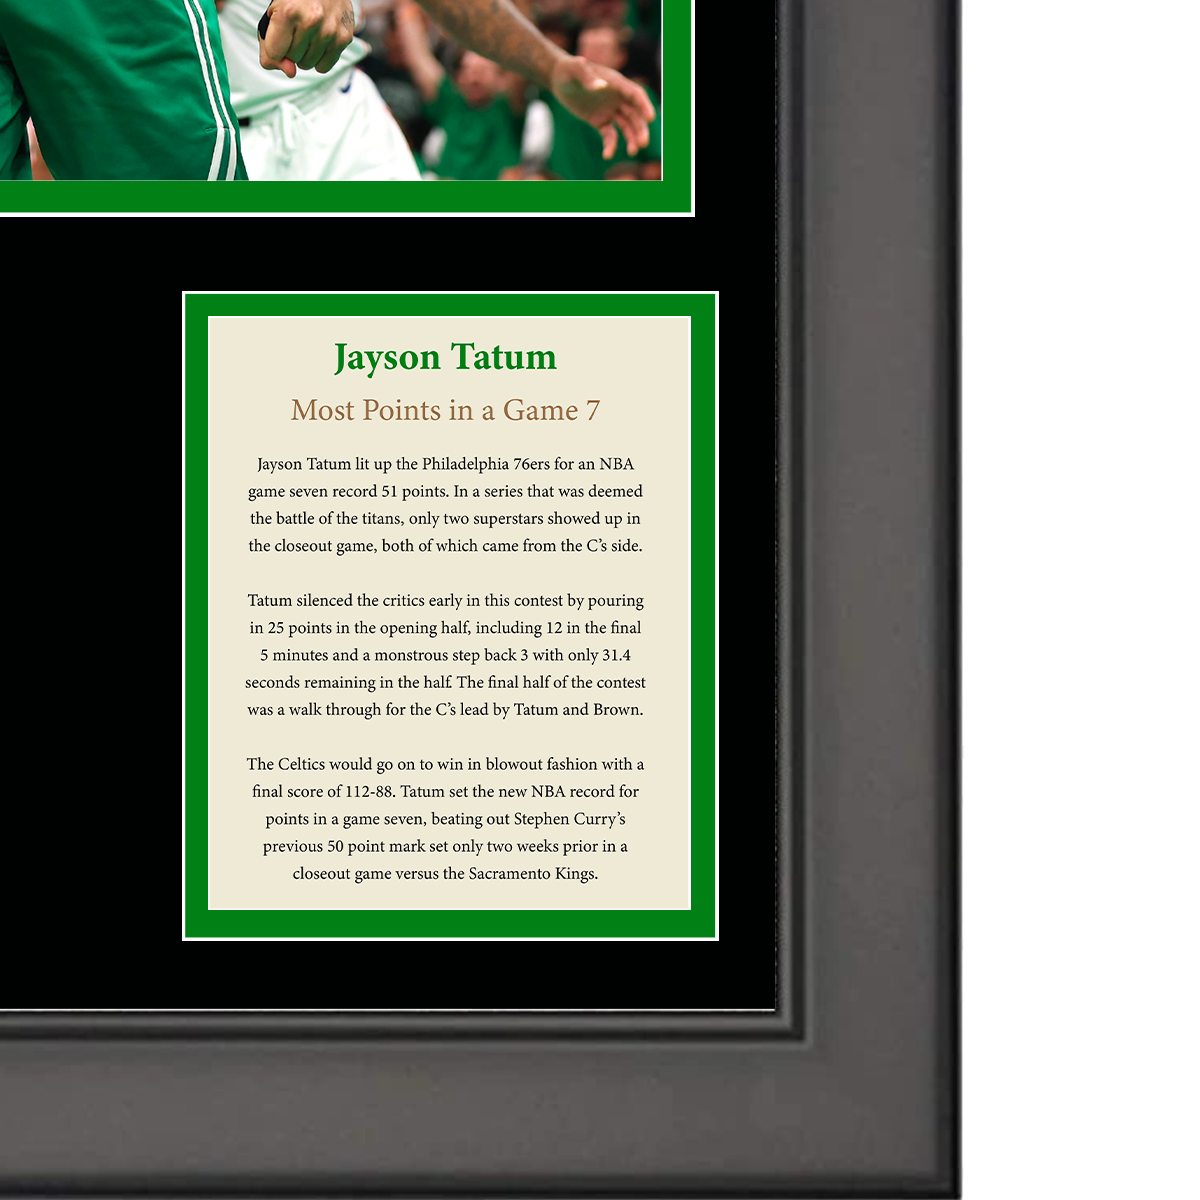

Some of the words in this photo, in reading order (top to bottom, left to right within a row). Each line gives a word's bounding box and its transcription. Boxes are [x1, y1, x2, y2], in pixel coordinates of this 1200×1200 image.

[334, 343, 441, 379] Jayson
[451, 342, 557, 370] Tatum
[291, 399, 354, 421] Most
[363, 399, 440, 421] Points
[449, 399, 473, 420] in
[482, 405, 495, 420] a
[504, 399, 578, 421] Game
[587, 400, 600, 420] 7
[258, 458, 302, 474] Jayson
[307, 457, 351, 470] Tatum
[356, 457, 369, 470] lit
[374, 461, 392, 474] up
[396, 457, 418, 470] the
[422, 457, 509, 474] Philadelphia
[514, 458, 550, 470] 76ers
[554, 457, 574, 470] for
[578, 461, 595, 470] an
[600, 458, 634, 470] NBA
[248, 488, 285, 501] game
[290, 488, 328, 497] seven
[333, 484, 377, 497] record
[382, 485, 397, 497] 51
[402, 485, 449, 501] points.
[454, 485, 468, 497] In
[473, 488, 480, 497] a
[485, 485, 523, 497] series
[527, 484, 554, 497] that
[558, 488, 584, 497] was
[588, 484, 643, 497] deemed
[250, 511, 272, 524] the
[276, 511, 314, 524] battle
[319, 511, 334, 524] of
[336, 511, 358, 524] the
[362, 512, 404, 526] titans,
[409, 511, 440, 528] only
[444, 514, 469, 524] two
[474, 513, 543, 528] superstars
[548, 511, 600, 524] showed
[605, 516, 622, 528] up
[627, 512, 640, 524] in
[249, 539, 270, 552] the
[275, 538, 332, 552] closeout
[337, 543, 377, 556] game,
[382, 538, 414, 552] both
[419, 538, 434, 552] of
[436, 538, 478, 552] which
[483, 543, 518, 552] came
[523, 538, 556, 552] from
[561, 538, 582, 552] the
[587, 538, 607, 552] C’s
[612, 539, 642, 552] side.
[248, 594, 292, 606] Tatum
[297, 593, 353, 606] silenced
[357, 593, 378, 606] the
[383, 594, 425, 606] critics
[429, 593, 463, 610] early
[467, 594, 480, 606] in
[485, 593, 509, 606] this
[514, 595, 563, 606] contest
[567, 593, 584, 610] by
[588, 594, 644, 611] pouring
[250, 621, 263, 634] in
[268, 622, 284, 634] 25
[289, 621, 332, 638] points
[336, 621, 350, 634] in
[354, 620, 376, 634] the
[380, 621, 437, 638] opening
[441, 620, 471, 635] half,
[476, 620, 542, 638] including
[547, 622, 562, 634] 12
[567, 621, 580, 634] in
[585, 621, 606, 634] the
[611, 620, 641, 634] final
[245, 675, 300, 688] seconds
[305, 676, 376, 693] remaining
[380, 676, 393, 688] in
[398, 675, 419, 688] the
[424, 675, 452, 688] half.
[457, 675, 484, 688] The
[488, 675, 519, 688] final
[523, 675, 551, 688] half
[553, 675, 569, 688] of
[571, 675, 592, 688] the
[597, 677, 646, 688] contest
[247, 707, 273, 716] was
[278, 707, 285, 715] a
[289, 702, 322, 715] walk
[326, 702, 381, 720] through
[386, 702, 406, 716] for
[410, 702, 431, 715] the
[436, 702, 456, 716] C’s
[460, 702, 489, 715] lead
[493, 702, 510, 719] by
[514, 703, 558, 715] Tatum
[563, 702, 589, 715] and
[594, 703, 643, 716] Brown.
[247, 757, 274, 770] The
[278, 757, 325, 770] Celtics
[329, 757, 372, 770] would
[377, 761, 393, 774] go
[398, 761, 415, 770] on
[420, 760, 433, 770] to
[437, 758, 463, 770] win
[468, 758, 481, 770] in
[486, 757, 543, 770] blowout
[547, 757, 597, 770] fashion
[602, 757, 632, 770] with
[637, 761, 644, 770] a
[253, 784, 283, 797] final
[288, 789, 323, 798] score
[328, 784, 344, 798] of
[345, 785, 395, 798] 112-88.
[400, 785, 445, 797] Tatum
[449, 787, 468, 798] set
[473, 784, 494, 797] the
[499, 789, 527, 797] new
[531, 785, 566, 797] NBA
[570, 784, 615, 798] record
[619, 784, 639, 798] for
[266, 813, 309, 829] points
[314, 813, 327, 825] in
[332, 816, 339, 825] a
[343, 816, 380, 829] game
[384, 816, 426, 826] seven,
[431, 812, 483, 829] beating
[487, 814, 510, 825] out
[515, 812, 569, 829] Stephen
[574, 811, 625, 829] Curry’s
[293, 866, 350, 880] closeout
[355, 870, 391, 884] game
[395, 871, 439, 880] versus
[443, 866, 464, 879] the
[469, 867, 550, 880] Sacramento
[556, 867, 598, 884] Kings.
